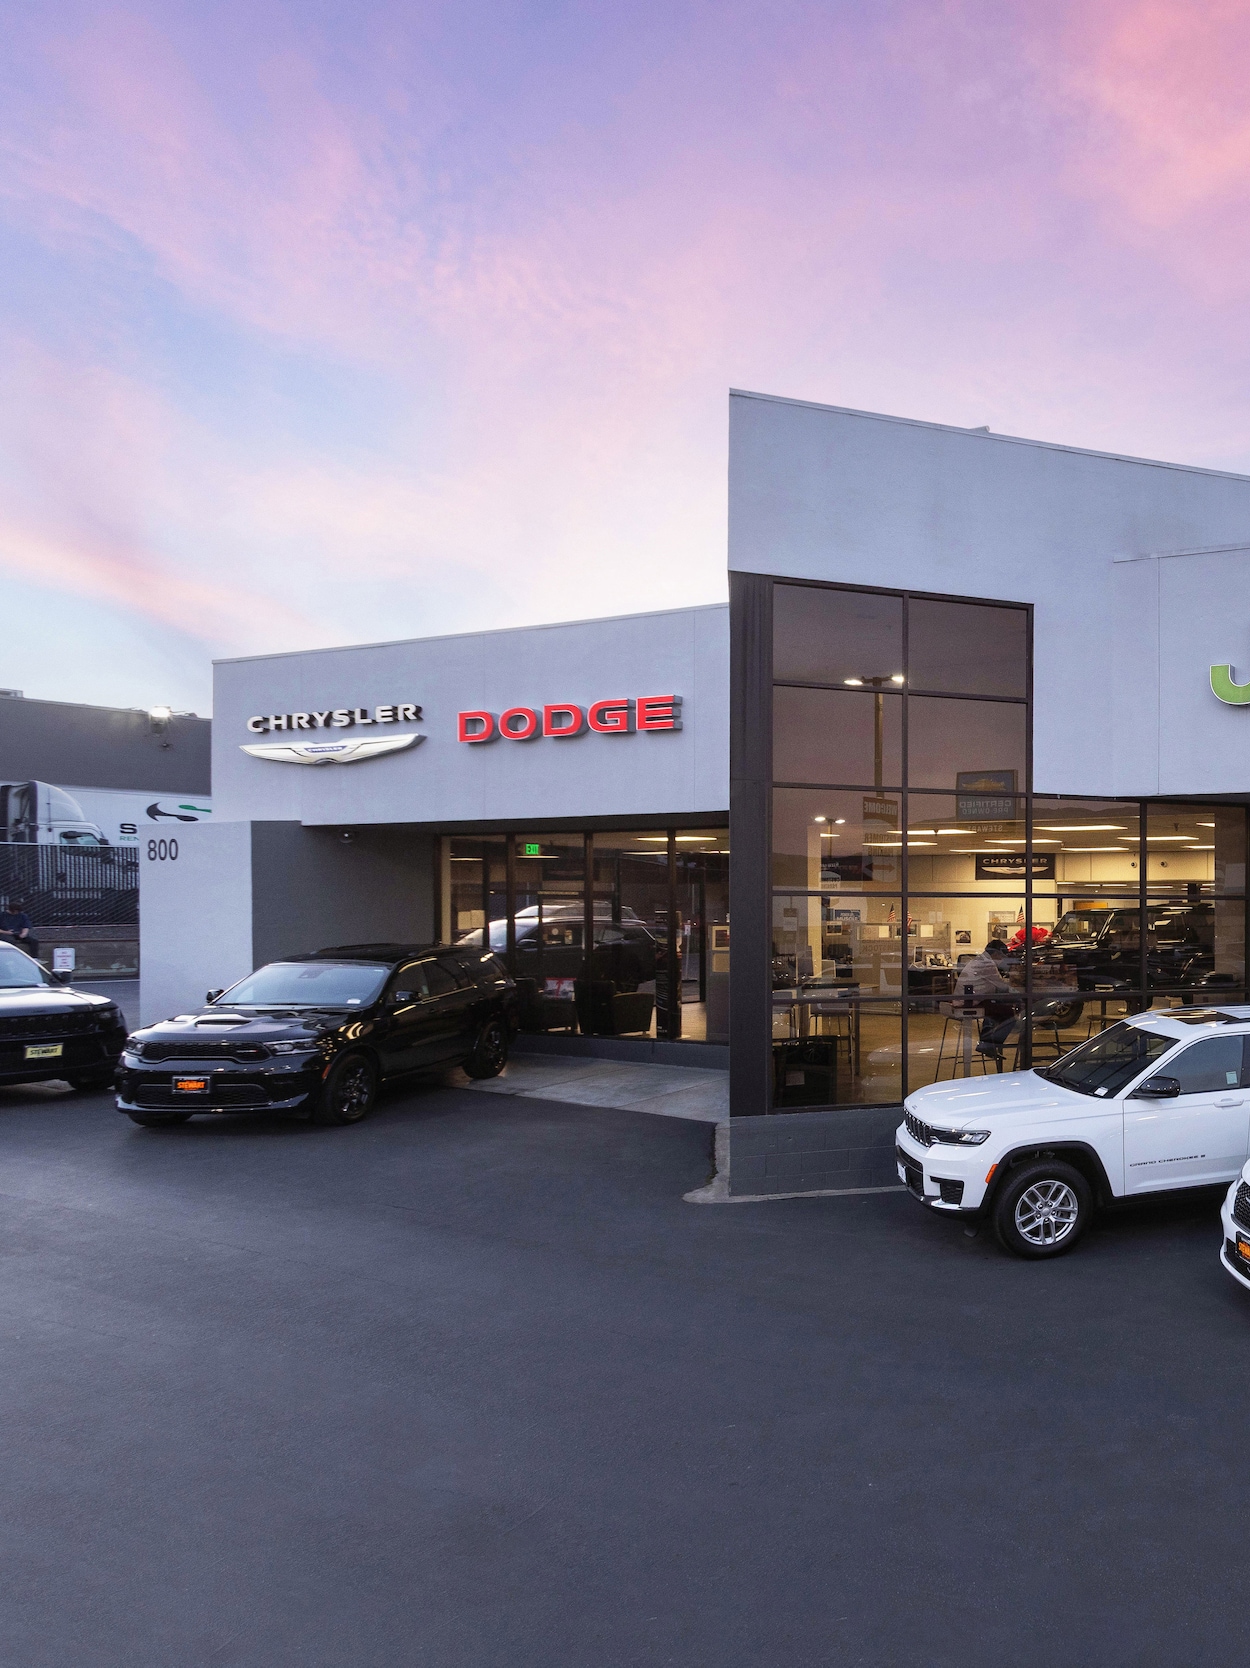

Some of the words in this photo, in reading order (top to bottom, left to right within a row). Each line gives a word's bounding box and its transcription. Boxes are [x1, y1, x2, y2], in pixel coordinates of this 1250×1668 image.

[246, 703, 423, 734] CHRYSLER
[457, 694, 682, 744] DODGE
[147, 838, 179, 861] 800
[526, 843, 539, 855] EXIT
[177, 1081, 206, 1090] STEWART
